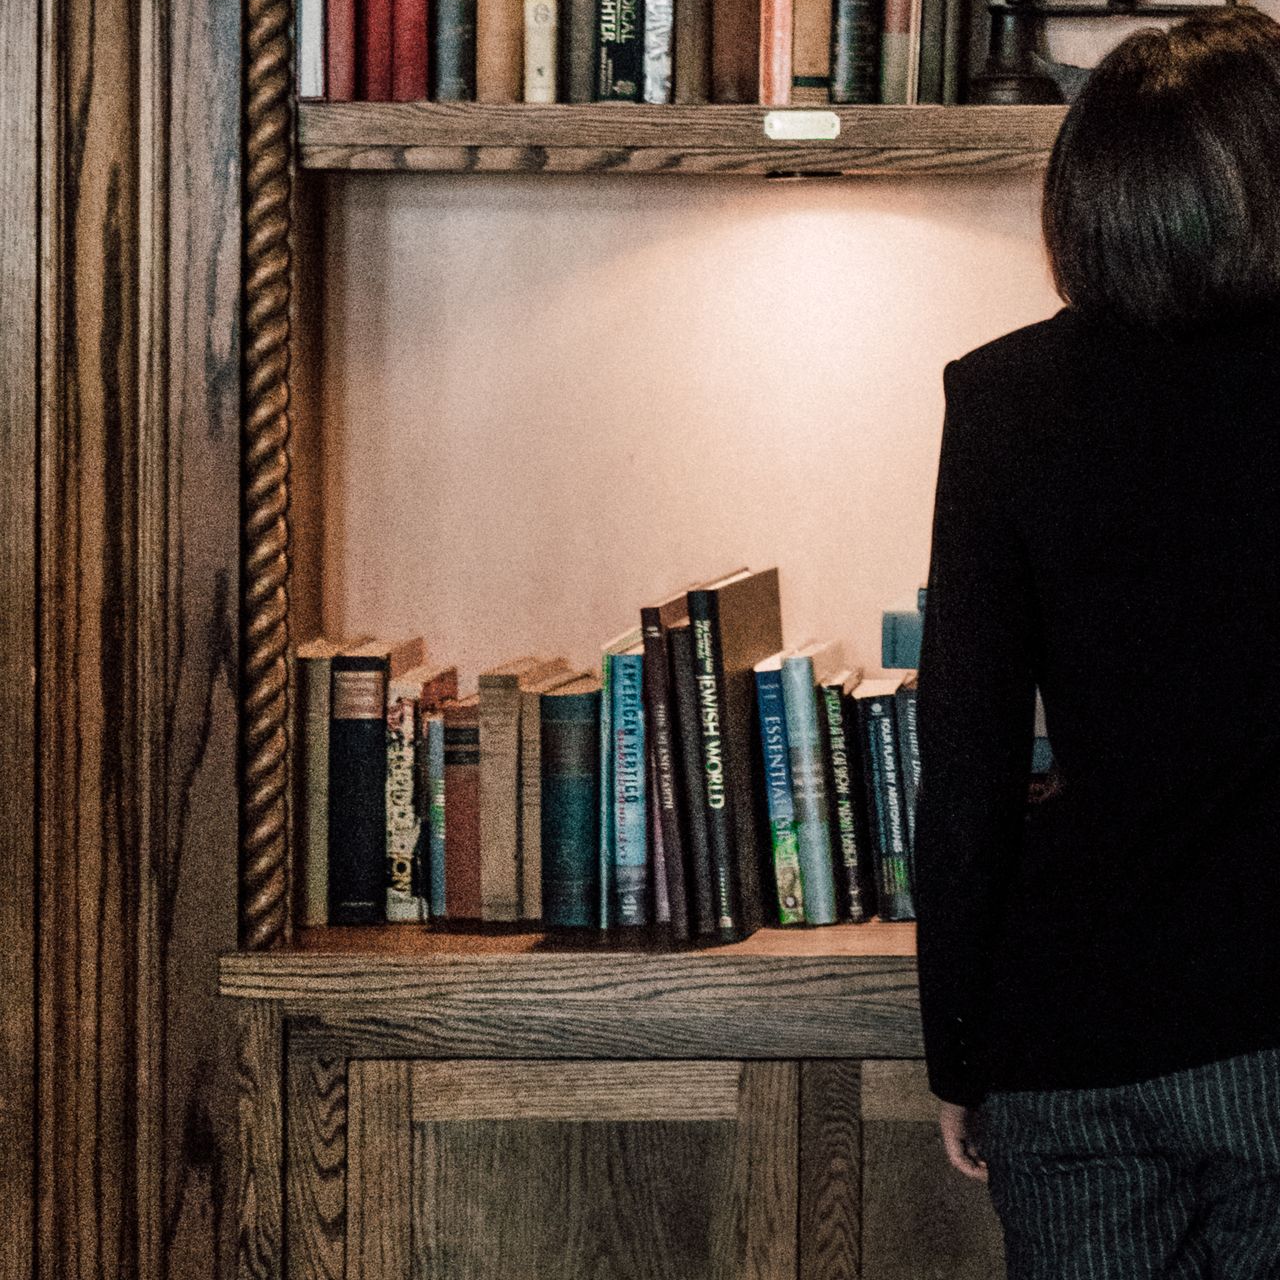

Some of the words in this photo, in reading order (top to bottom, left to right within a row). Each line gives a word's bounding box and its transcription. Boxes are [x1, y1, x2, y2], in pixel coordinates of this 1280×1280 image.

[623, 663, 638, 736] AMERICAN
[697, 674, 721, 737] JEWISH
[623, 742, 638, 804] VERTIGO
[705, 739, 726, 810] WORLD
[764, 715, 791, 806] ESSENTIAL
